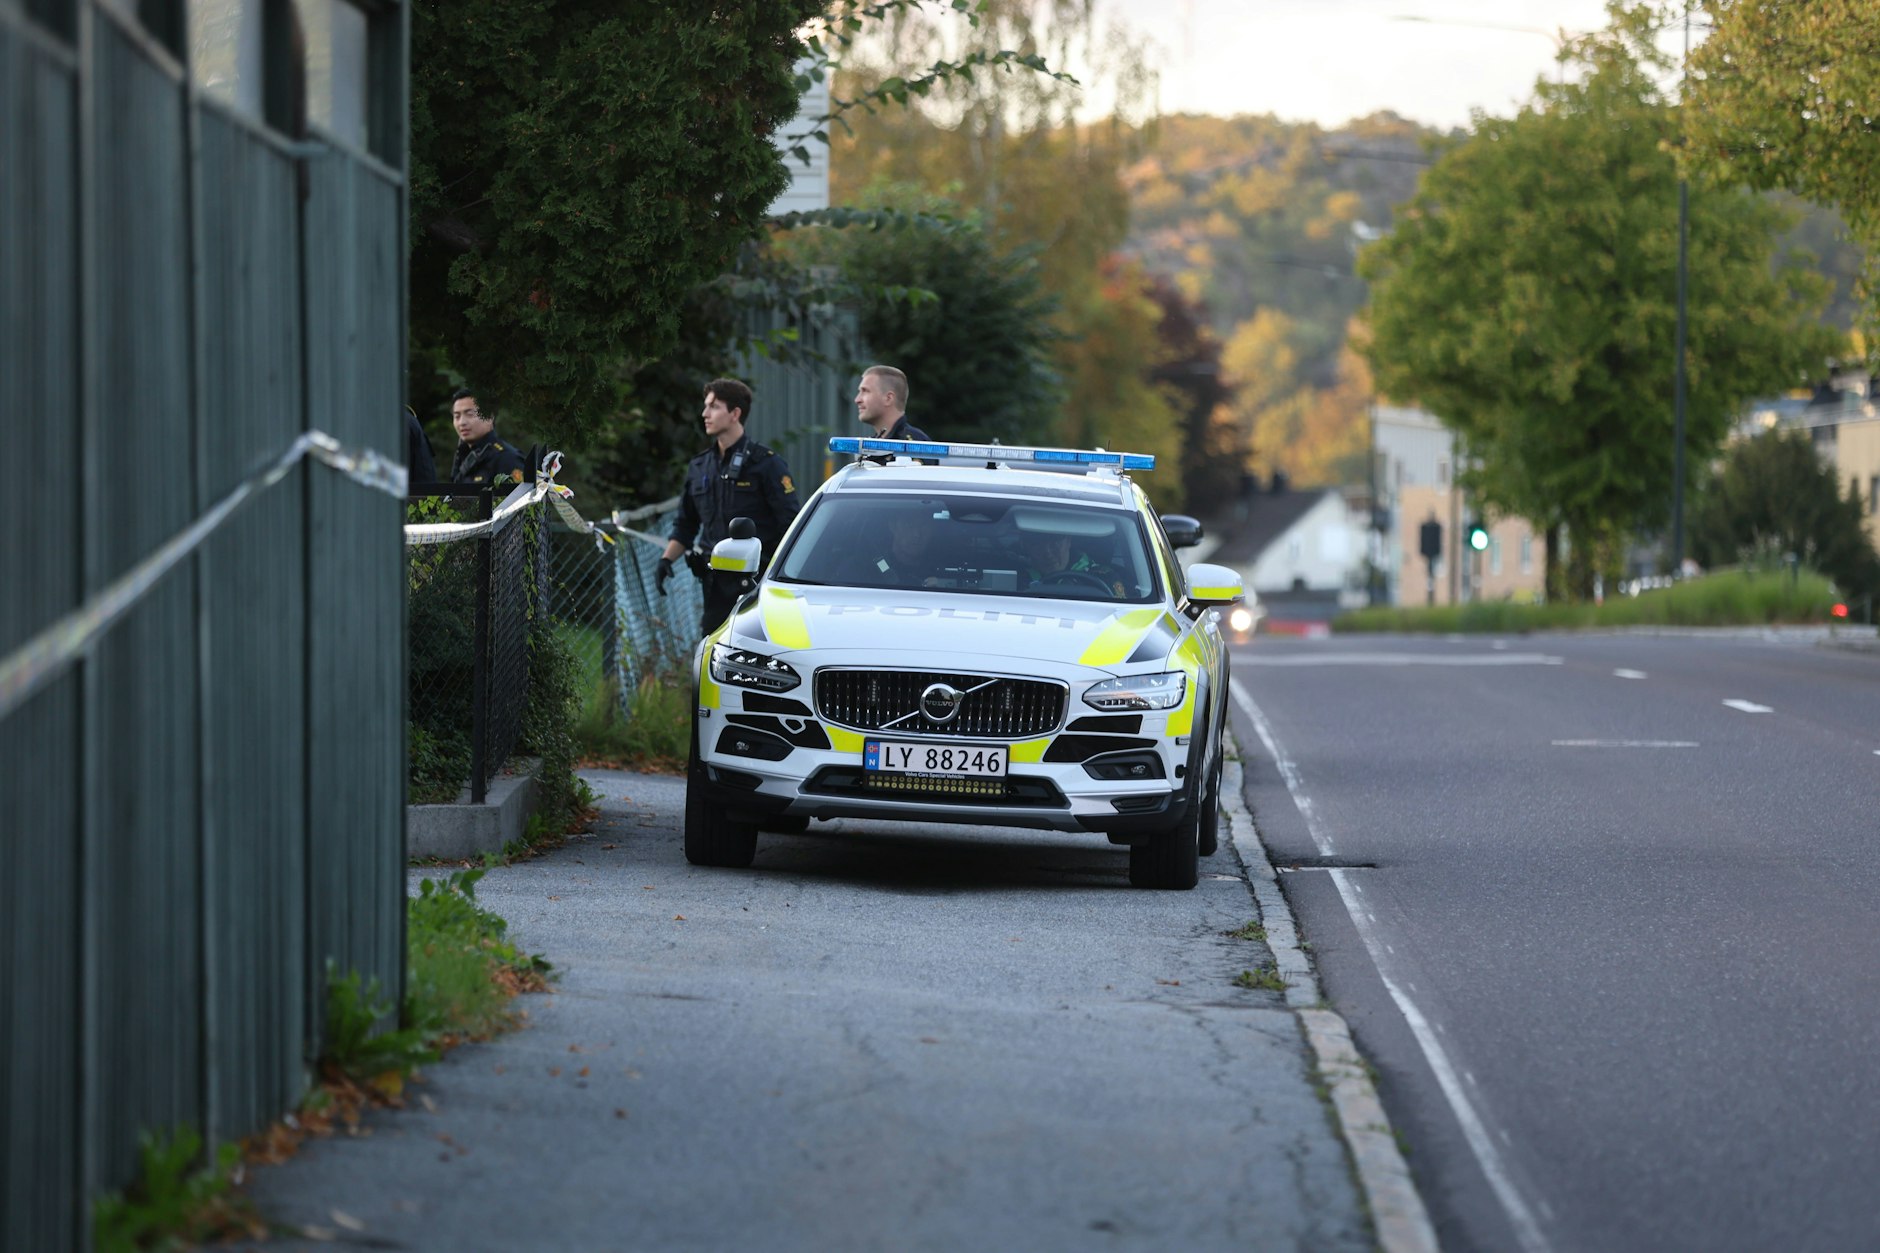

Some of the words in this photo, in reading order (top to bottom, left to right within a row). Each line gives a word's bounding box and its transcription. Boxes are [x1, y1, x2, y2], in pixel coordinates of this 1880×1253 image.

[828, 604, 1076, 629] POLITI
[885, 746, 913, 768] LY
[925, 748, 1000, 773] 88246
